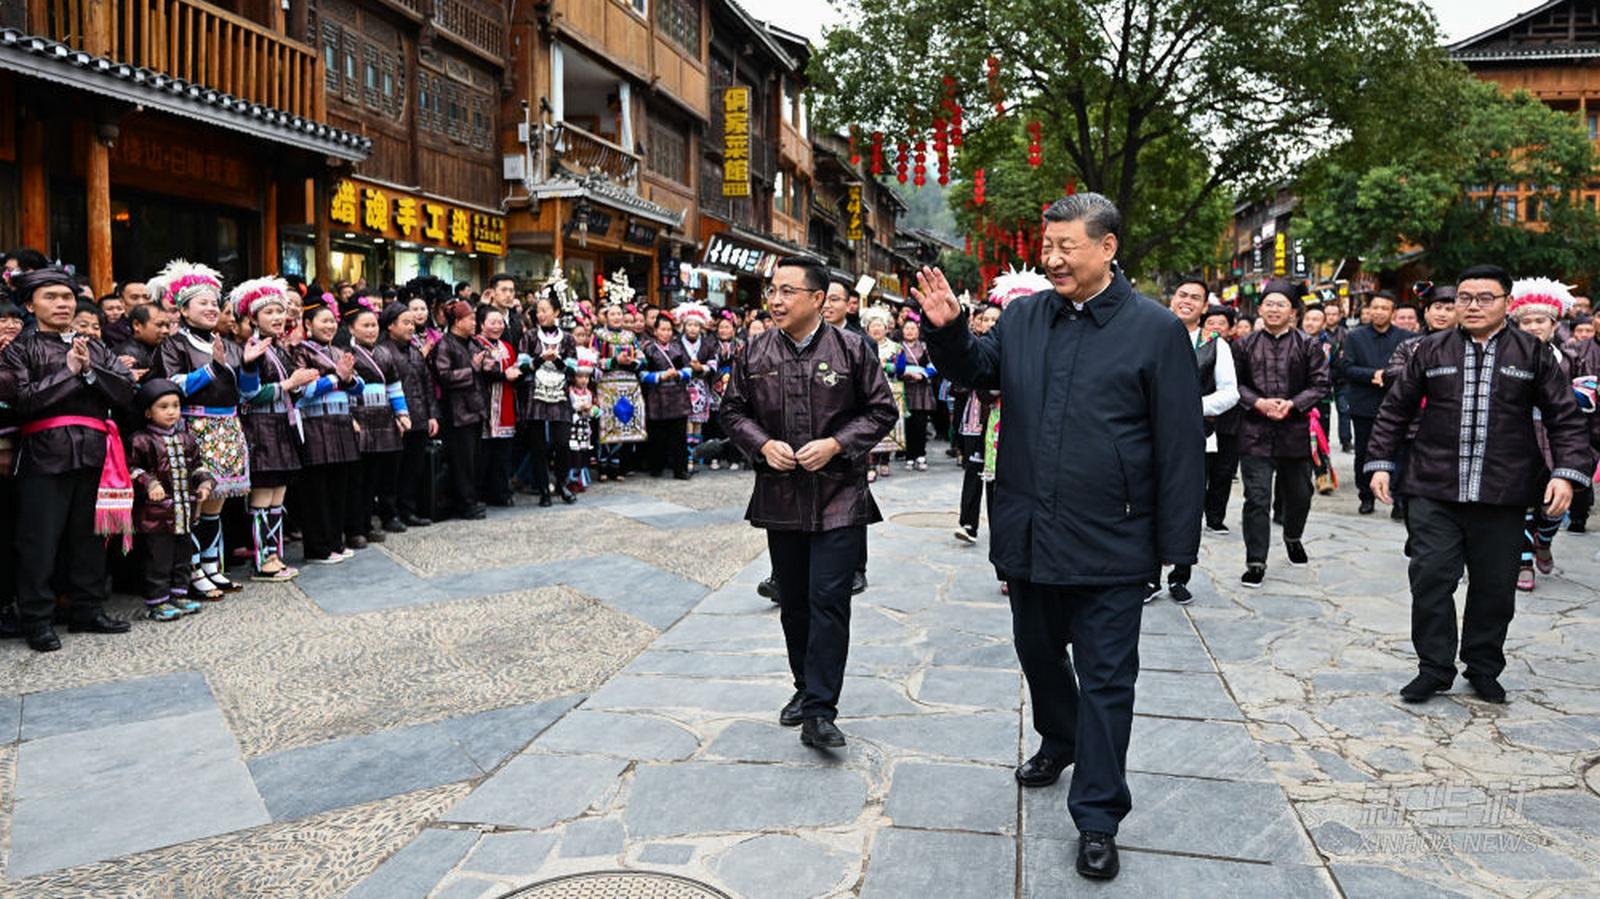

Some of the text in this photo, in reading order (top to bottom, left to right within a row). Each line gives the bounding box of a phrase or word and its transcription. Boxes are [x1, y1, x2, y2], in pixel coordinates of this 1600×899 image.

[331, 179, 469, 245] 蜡魂手工染
